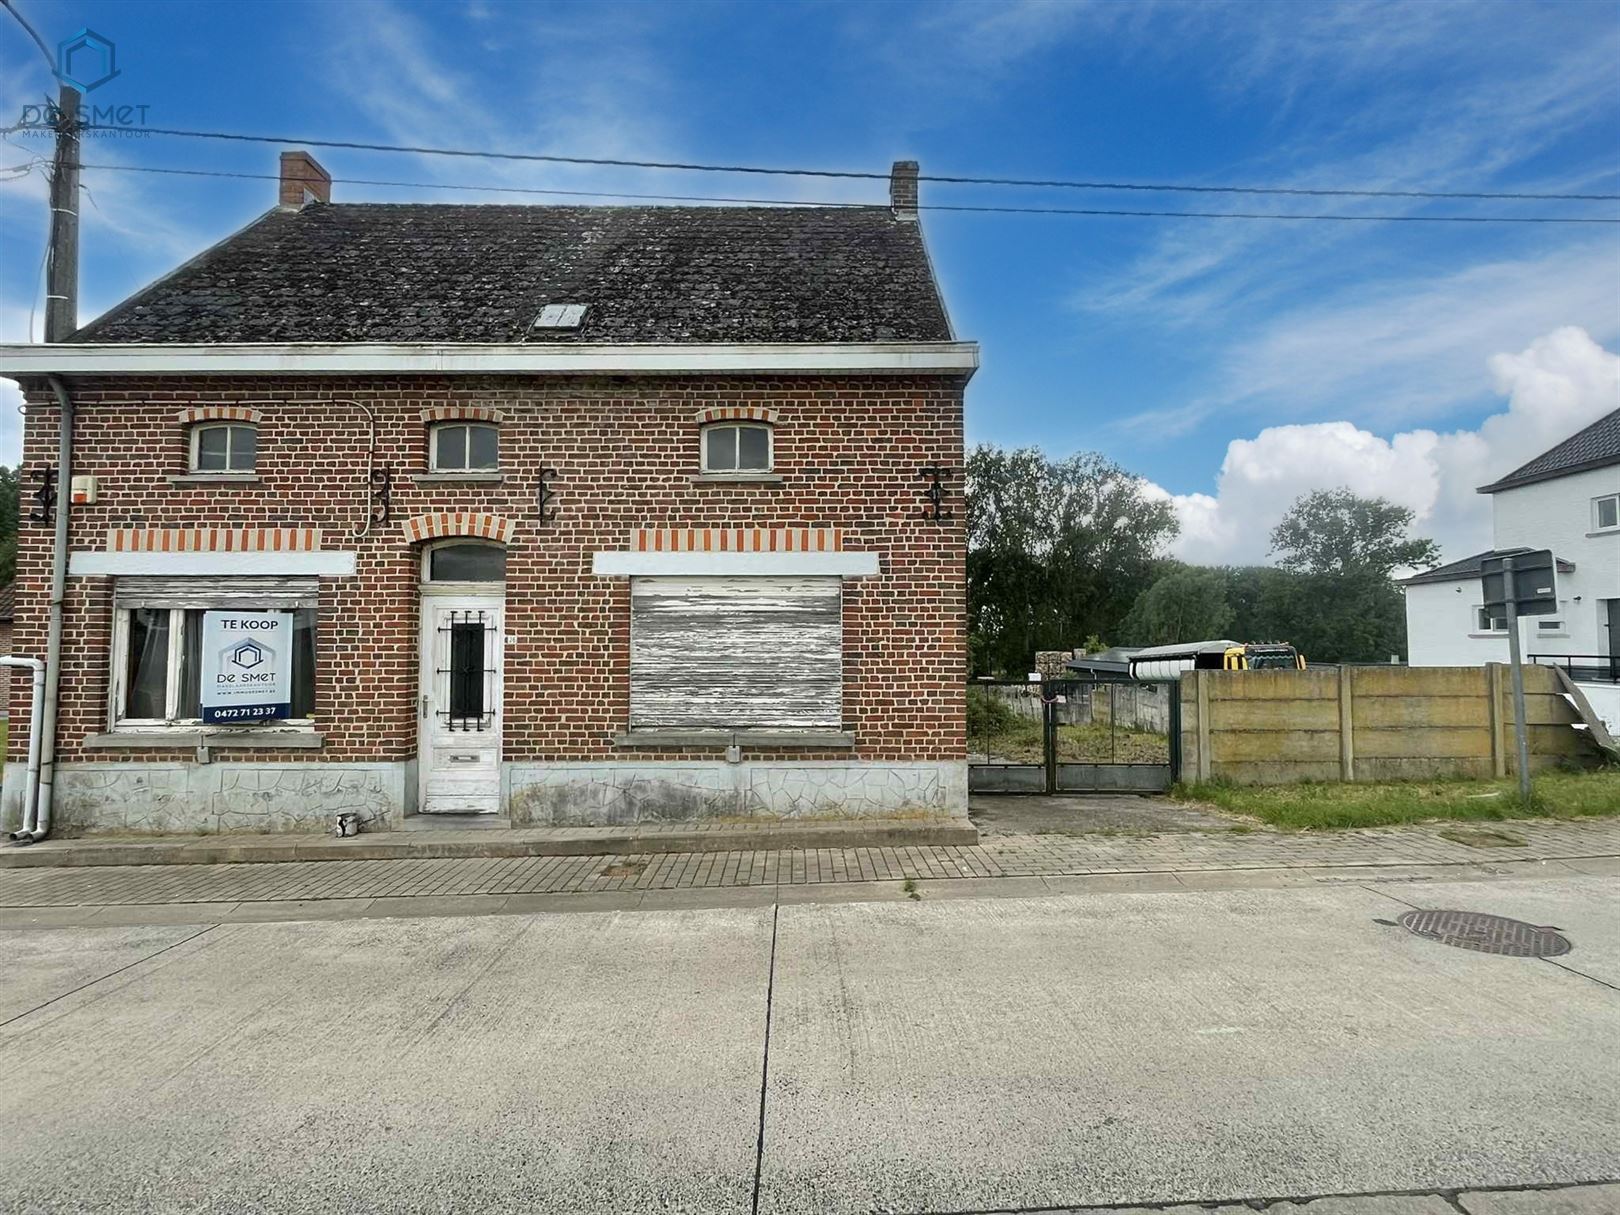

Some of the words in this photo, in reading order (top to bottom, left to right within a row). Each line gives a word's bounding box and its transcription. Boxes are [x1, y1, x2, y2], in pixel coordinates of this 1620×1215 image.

[220, 619, 238, 630] TE
[240, 620, 279, 630] KOOP
[214, 709, 239, 719] 0472
[240, 708, 250, 717] 71
[252, 707, 264, 716] 23
[265, 706, 276, 715] 37
